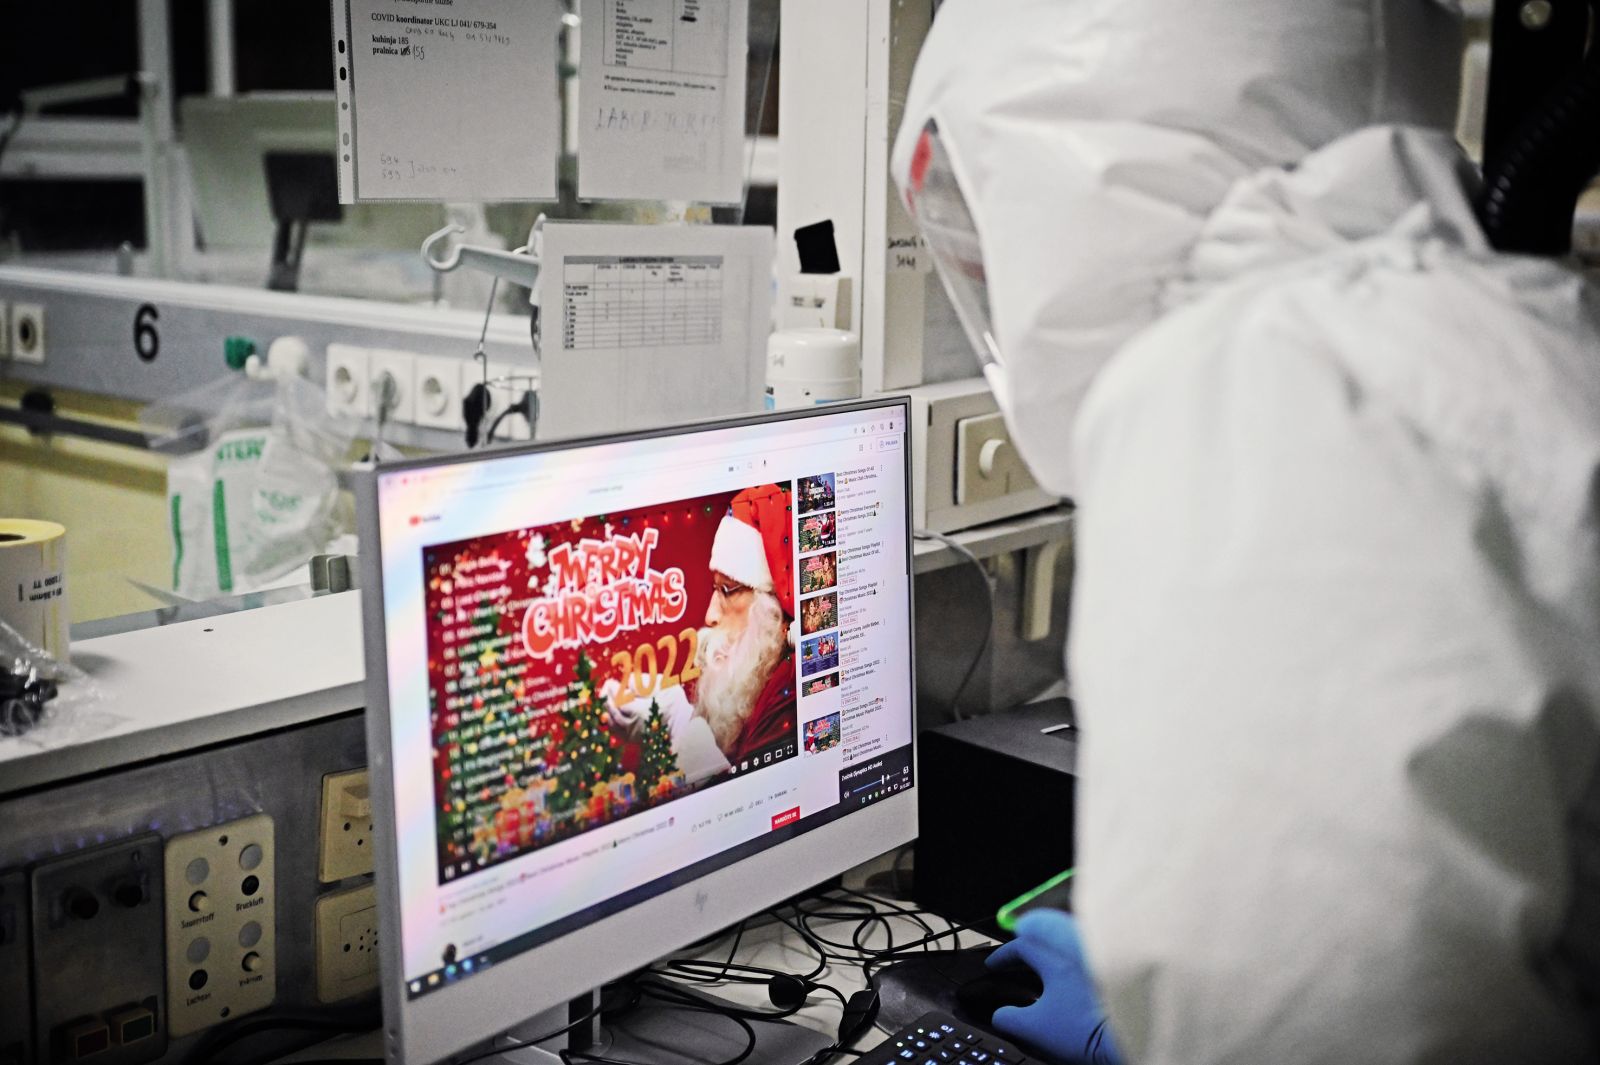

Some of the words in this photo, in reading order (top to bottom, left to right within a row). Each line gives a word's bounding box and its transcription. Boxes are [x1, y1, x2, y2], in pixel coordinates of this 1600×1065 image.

[371, 13, 394, 22] COVID
[396, 15, 433, 25] koordinator
[434, 18, 449, 27] UKC
[451, 19, 459, 27] LJ
[372, 35, 397, 45] kuhinja
[372, 46, 398, 55] pralnica
[133, 303, 161, 363] 6
[549, 528, 659, 592] MERRY
[522, 567, 687, 659] CHRISTMAS
[610, 627, 701, 707] 2022
